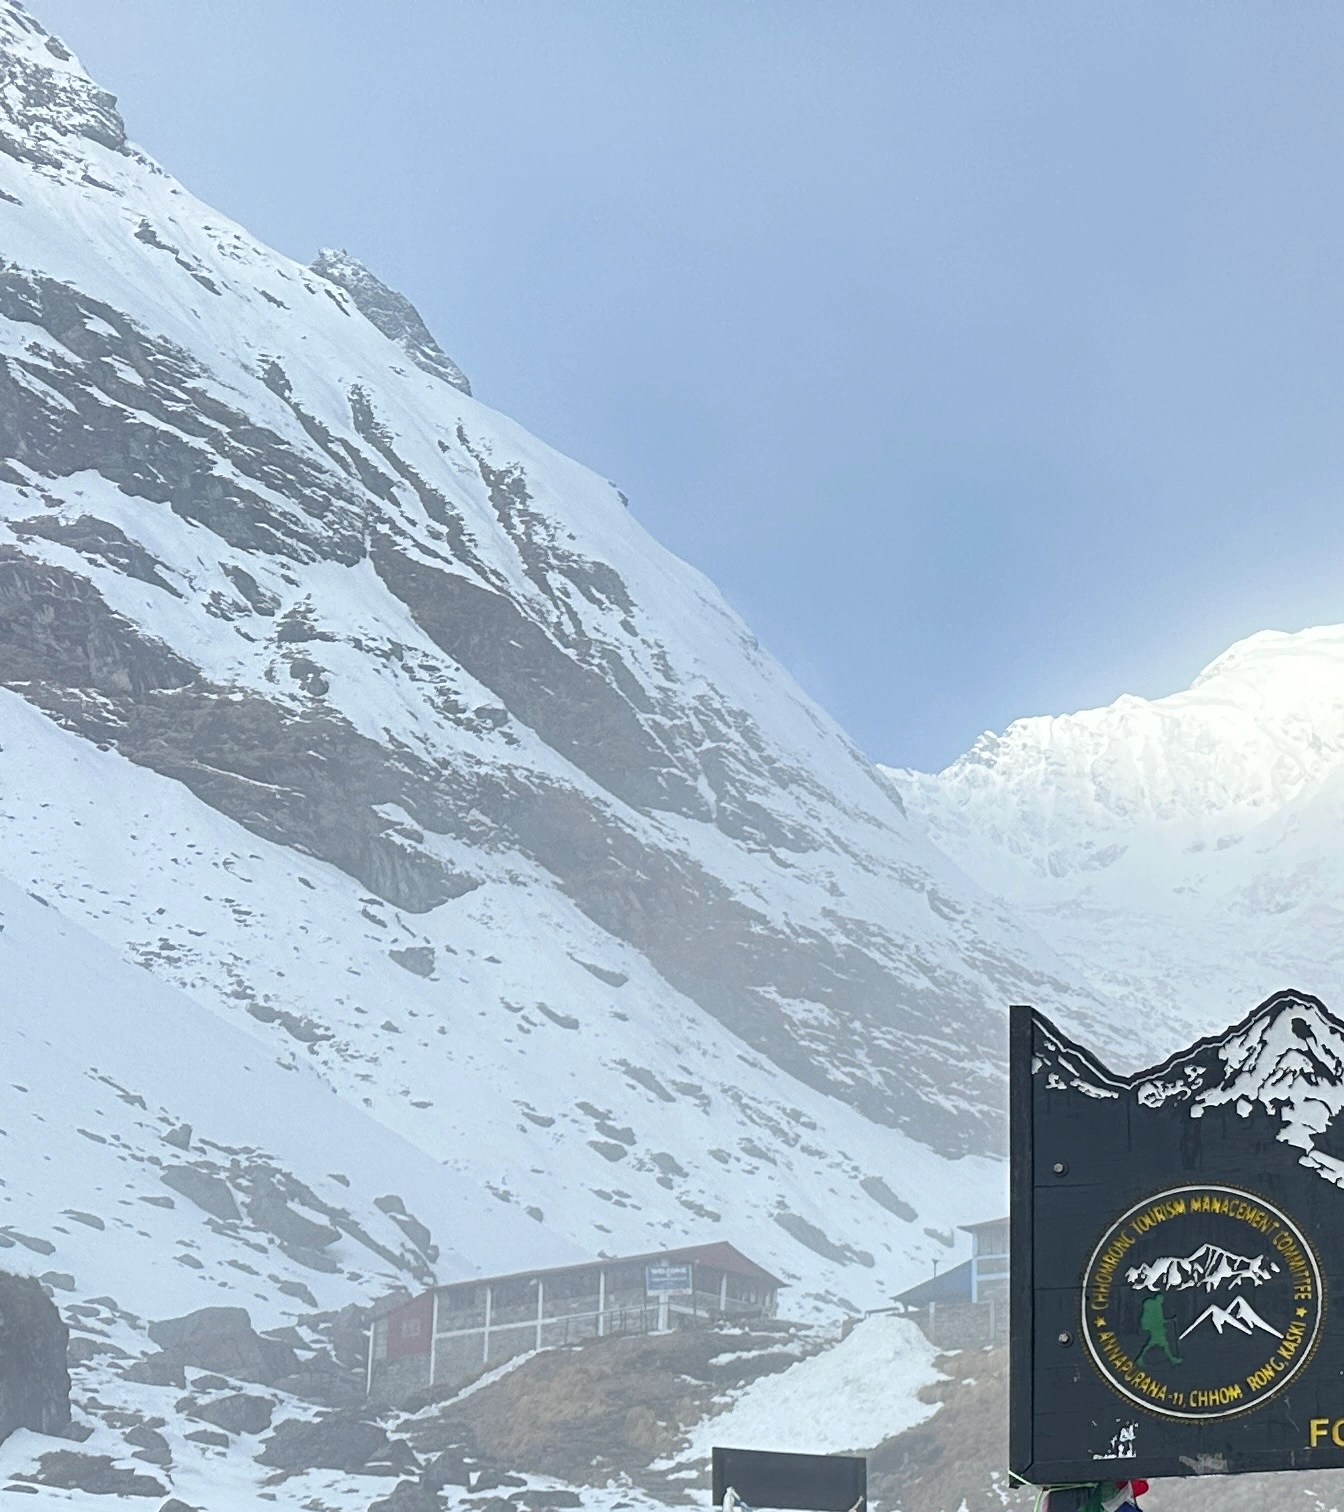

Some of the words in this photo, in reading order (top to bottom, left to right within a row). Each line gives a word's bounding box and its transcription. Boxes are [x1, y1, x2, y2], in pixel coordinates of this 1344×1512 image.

[1131, 1198, 1187, 1235] TOURISM
[1272, 1232, 1311, 1300] COMMITTEE
[1282, 1320, 1309, 1361] KASKI
